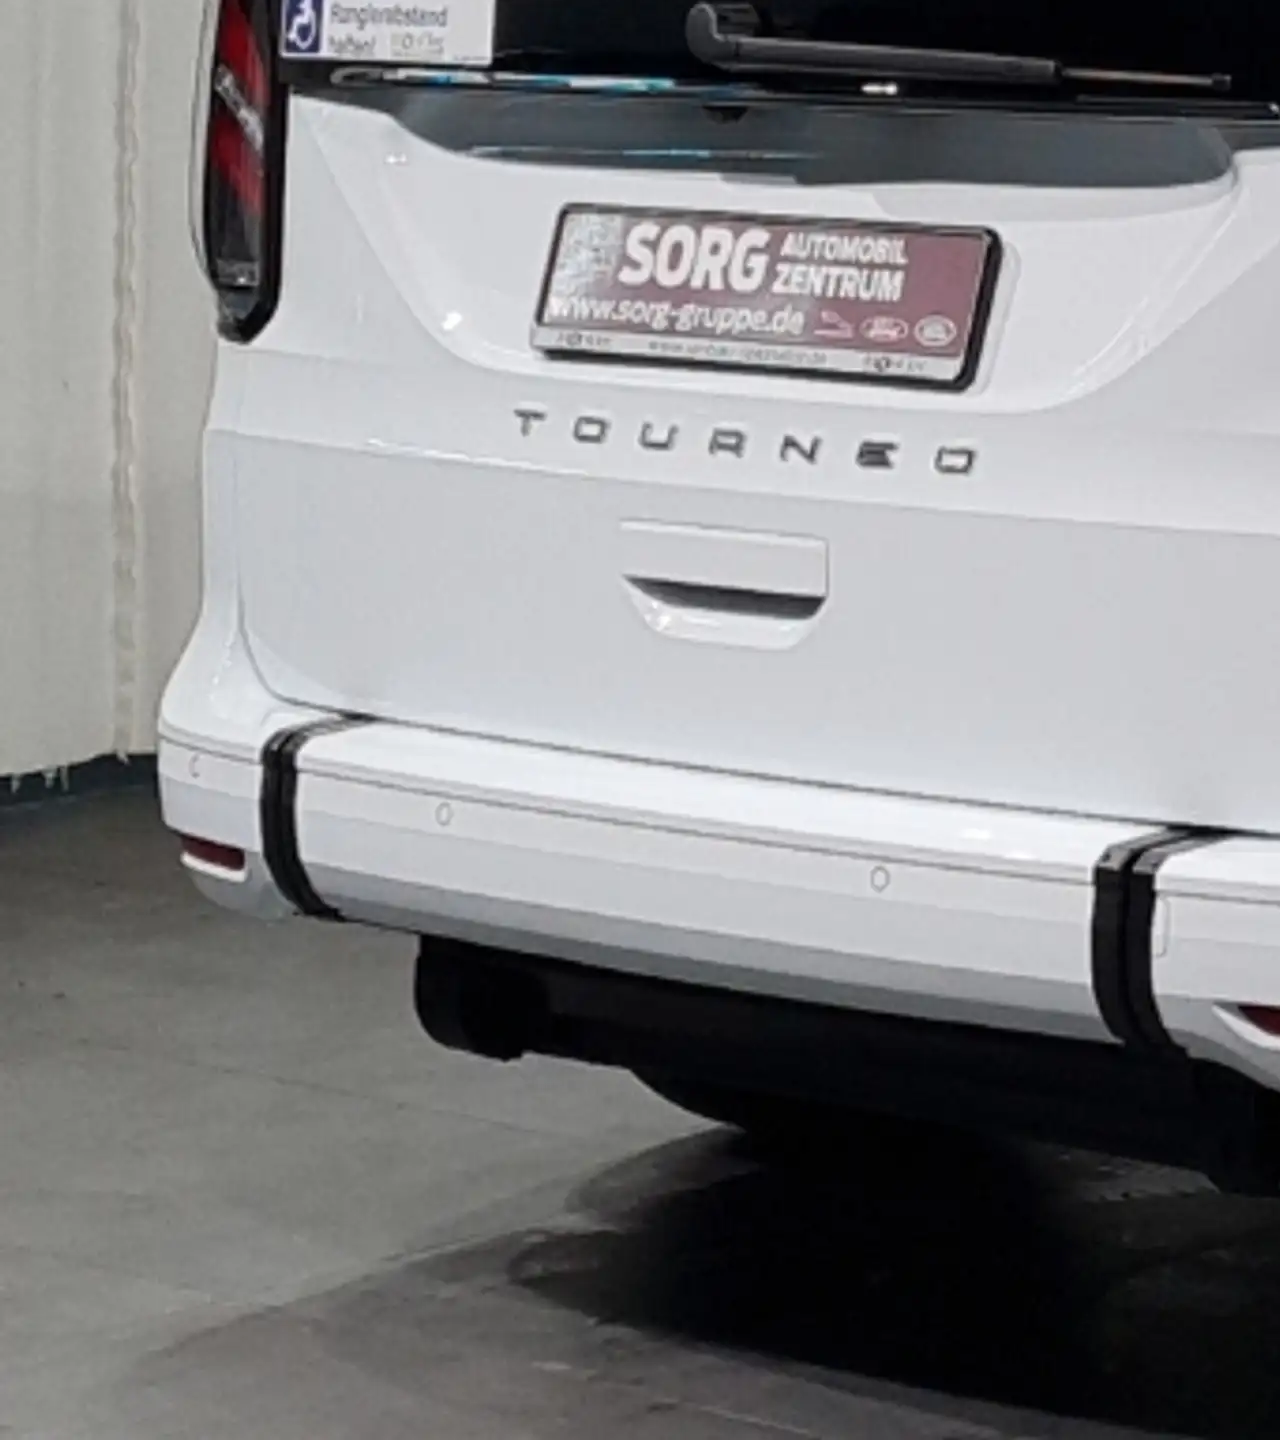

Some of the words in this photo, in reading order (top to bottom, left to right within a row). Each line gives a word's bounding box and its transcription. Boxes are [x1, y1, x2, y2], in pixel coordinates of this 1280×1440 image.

[618, 220, 772, 293] SORG
[779, 231, 909, 265] AUTOMOBIL
[771, 263, 906, 302] ZENTRUM
[546, 295, 806, 336] www.sorg-gruppe.de
[514, 407, 978, 476] TOURNEO
